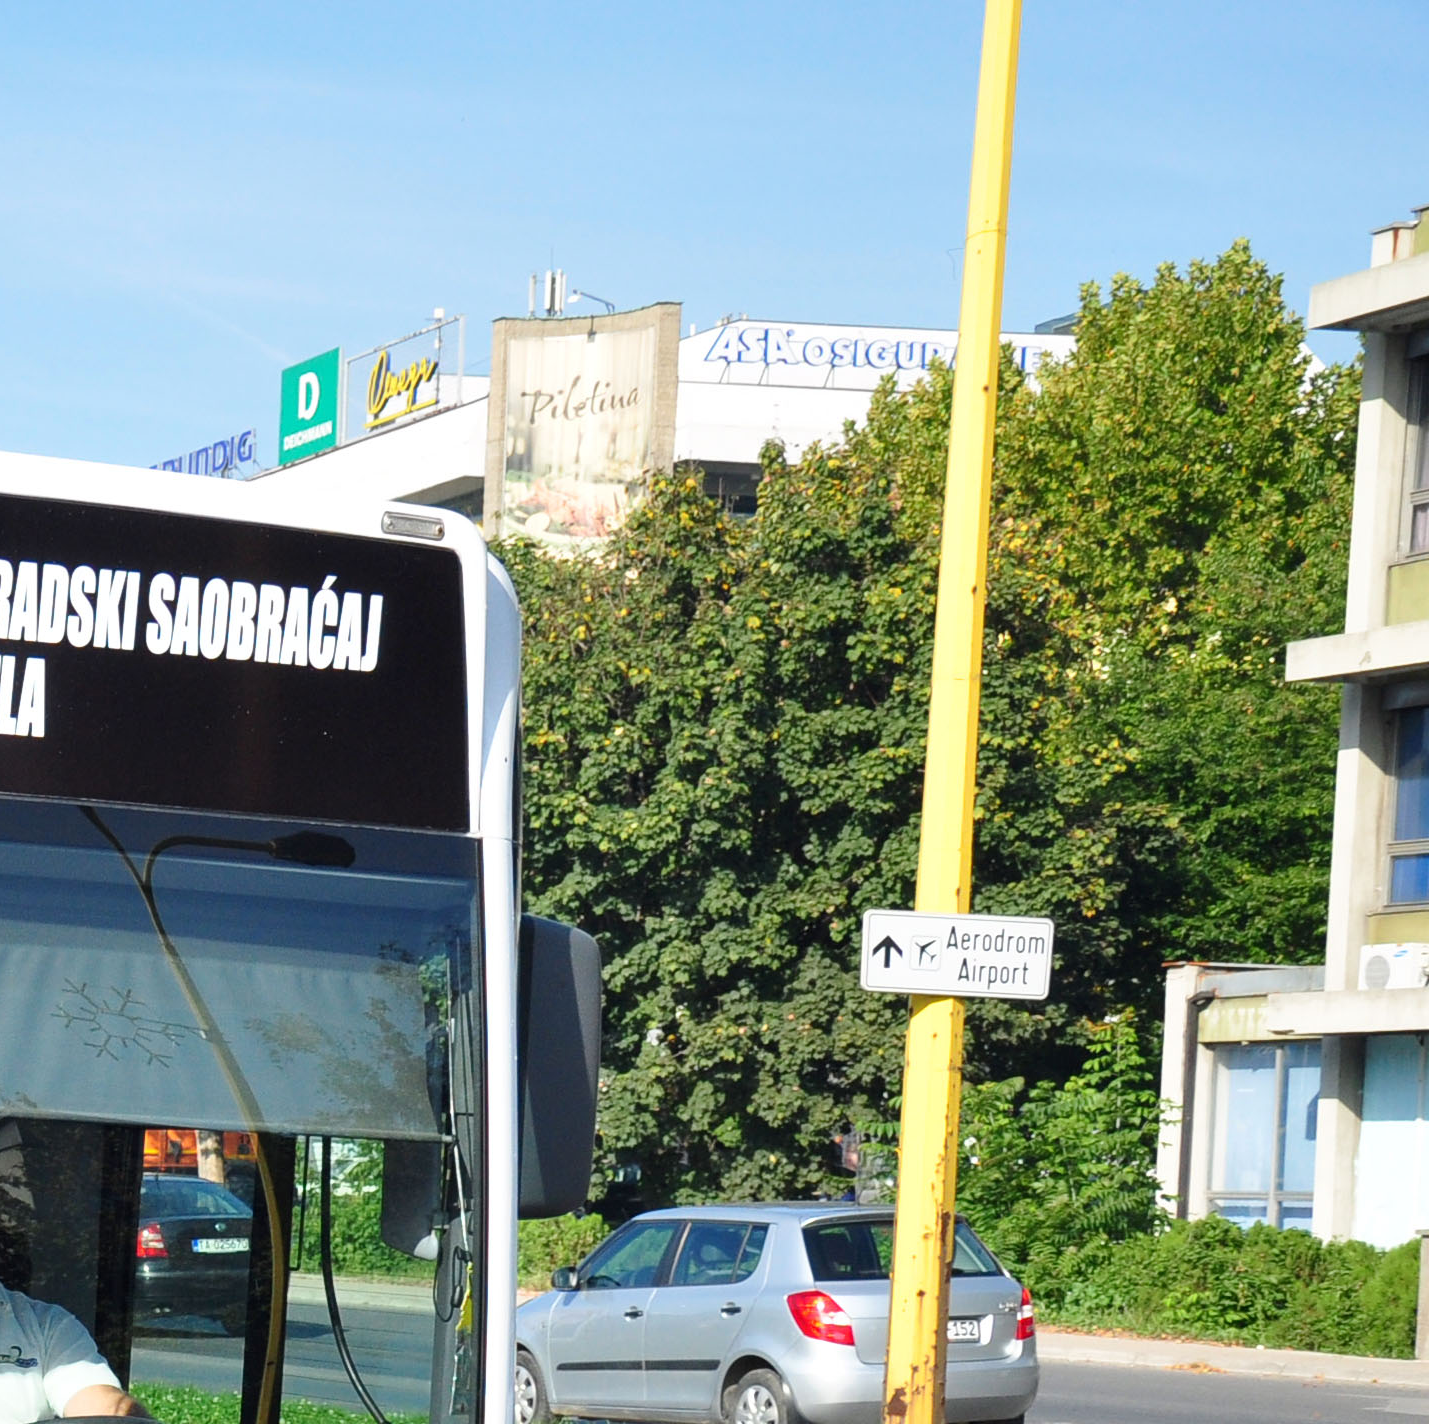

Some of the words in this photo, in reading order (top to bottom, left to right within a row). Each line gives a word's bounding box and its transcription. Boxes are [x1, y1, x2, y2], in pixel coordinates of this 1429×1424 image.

[297, 371, 320, 421] D
[520, 375, 640, 425] Piletina
[283, 421, 333, 451] DEICHMANN
[146, 573, 384, 672] SAOBRAĆAJ
[946, 926, 1046, 955] Aerodrom
[957, 957, 1029, 990] Airport
